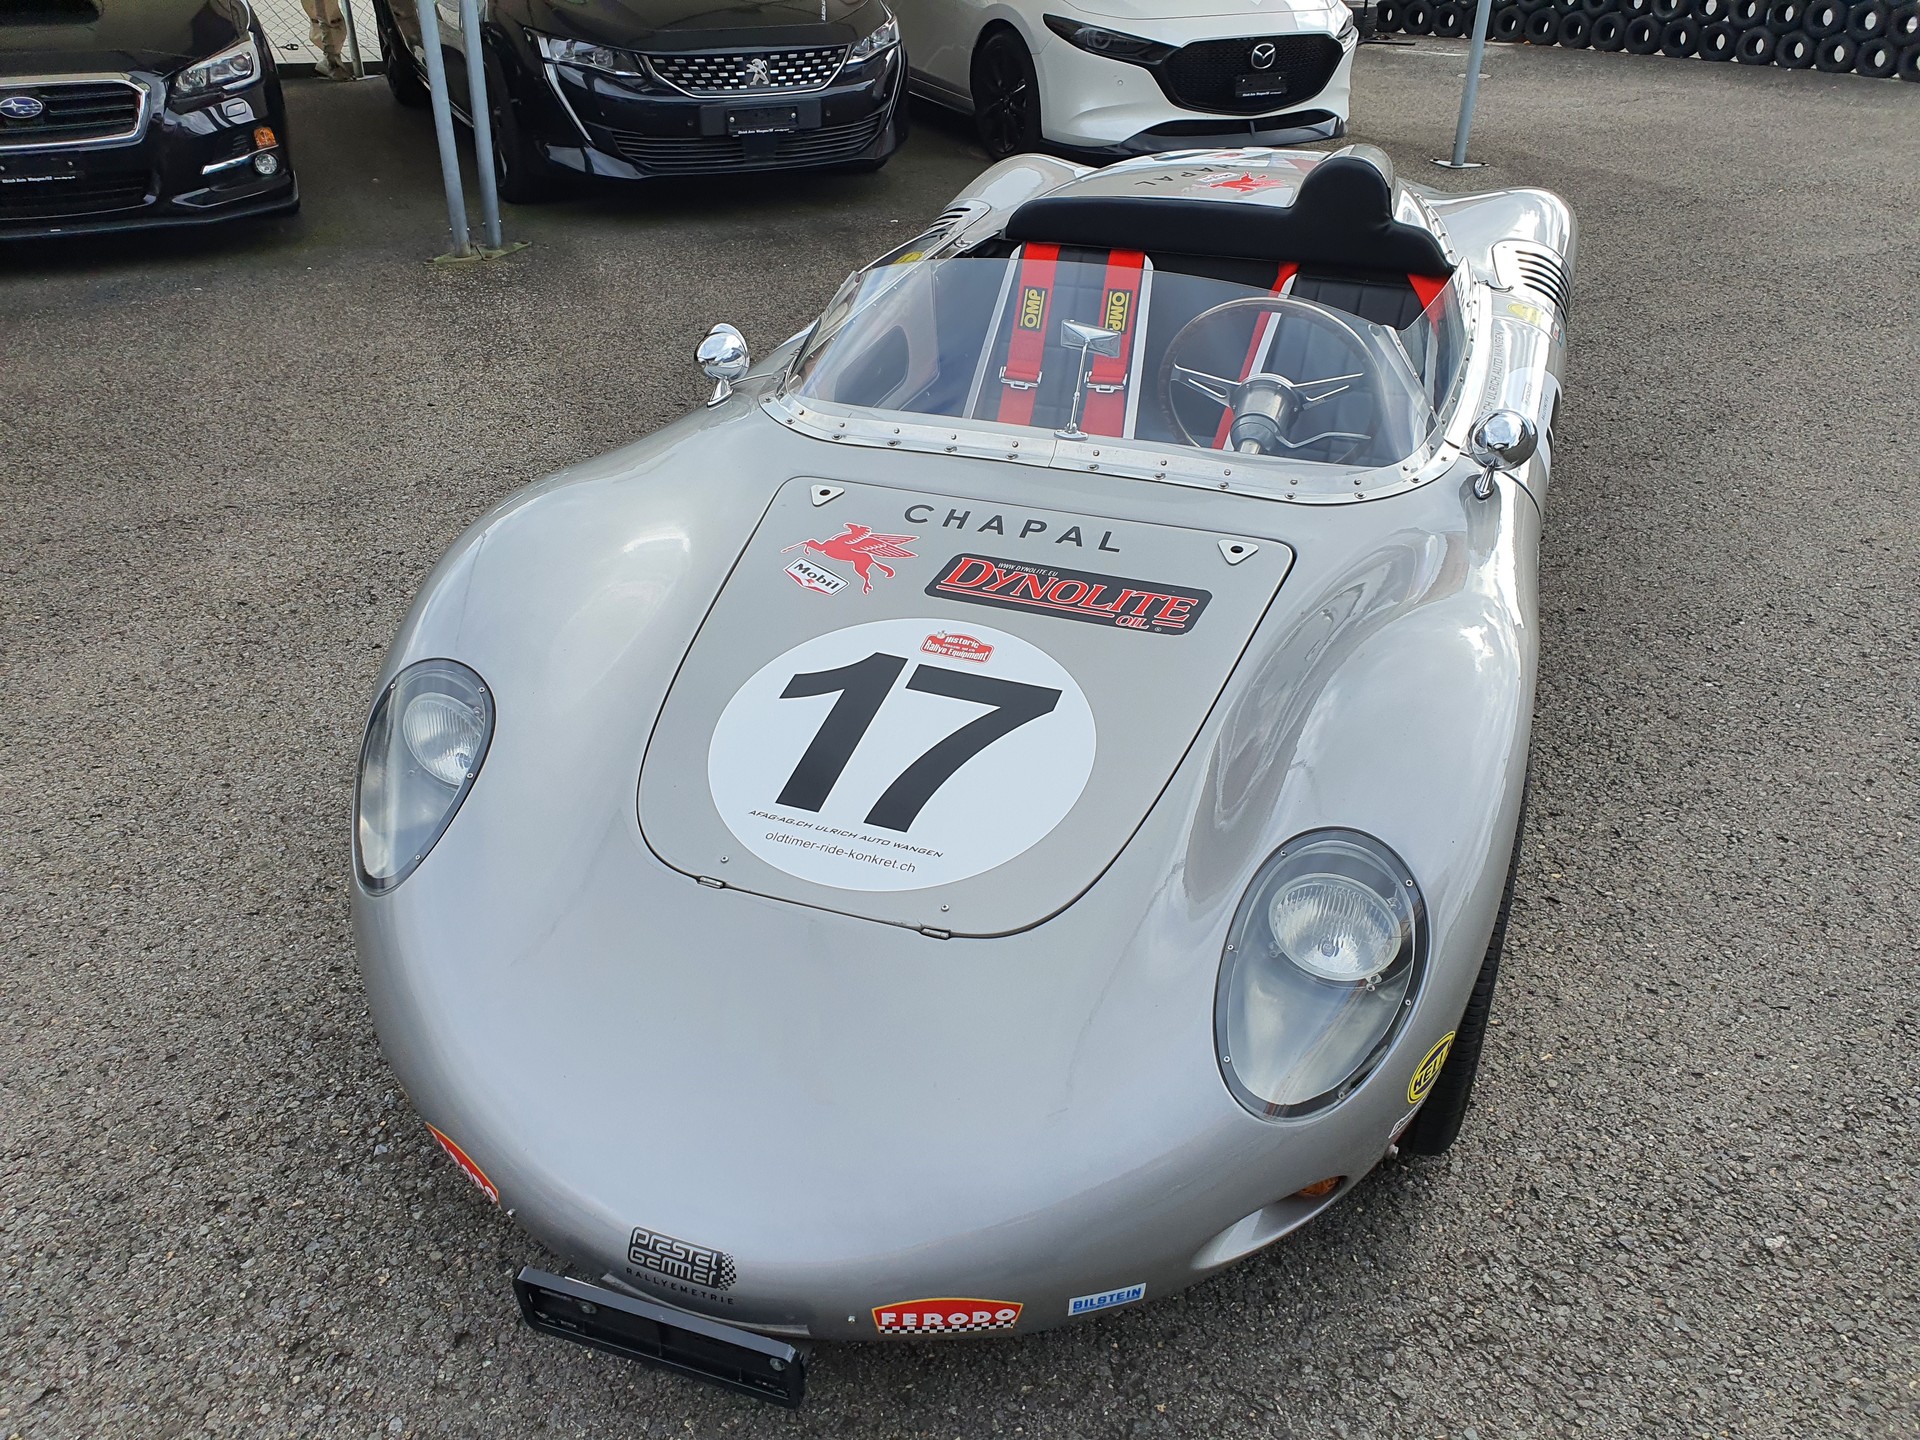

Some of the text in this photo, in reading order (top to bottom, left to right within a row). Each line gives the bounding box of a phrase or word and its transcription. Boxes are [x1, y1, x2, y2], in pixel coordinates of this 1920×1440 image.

[1023, 289, 1041, 328] OMP
[1109, 291, 1126, 332] OMP
[1492, 357, 1504, 376] AUTO
[904, 504, 1121, 553] CHAPAL
[793, 563, 840, 590] Mobil
[997, 562, 1059, 577] WWW.DYNOLITE.EU
[941, 557, 1198, 622] DYNOLITE
[1115, 614, 1150, 630] OIL
[923, 639, 948, 654] Rallye
[948, 648, 989, 661] Equipment
[944, 636, 980, 649] Historic
[775, 651, 1063, 833] 17
[748, 809, 944, 858] AFAG-AG.CH ULRICH AUTO WANGEN
[765, 831, 916, 873] oldtimer-ride-konkret.ch
[626, 1267, 734, 1305] RALLYEMETRIE
[1073, 1287, 1142, 1310] BILSTEIN
[881, 1308, 1017, 1326] FERODO
